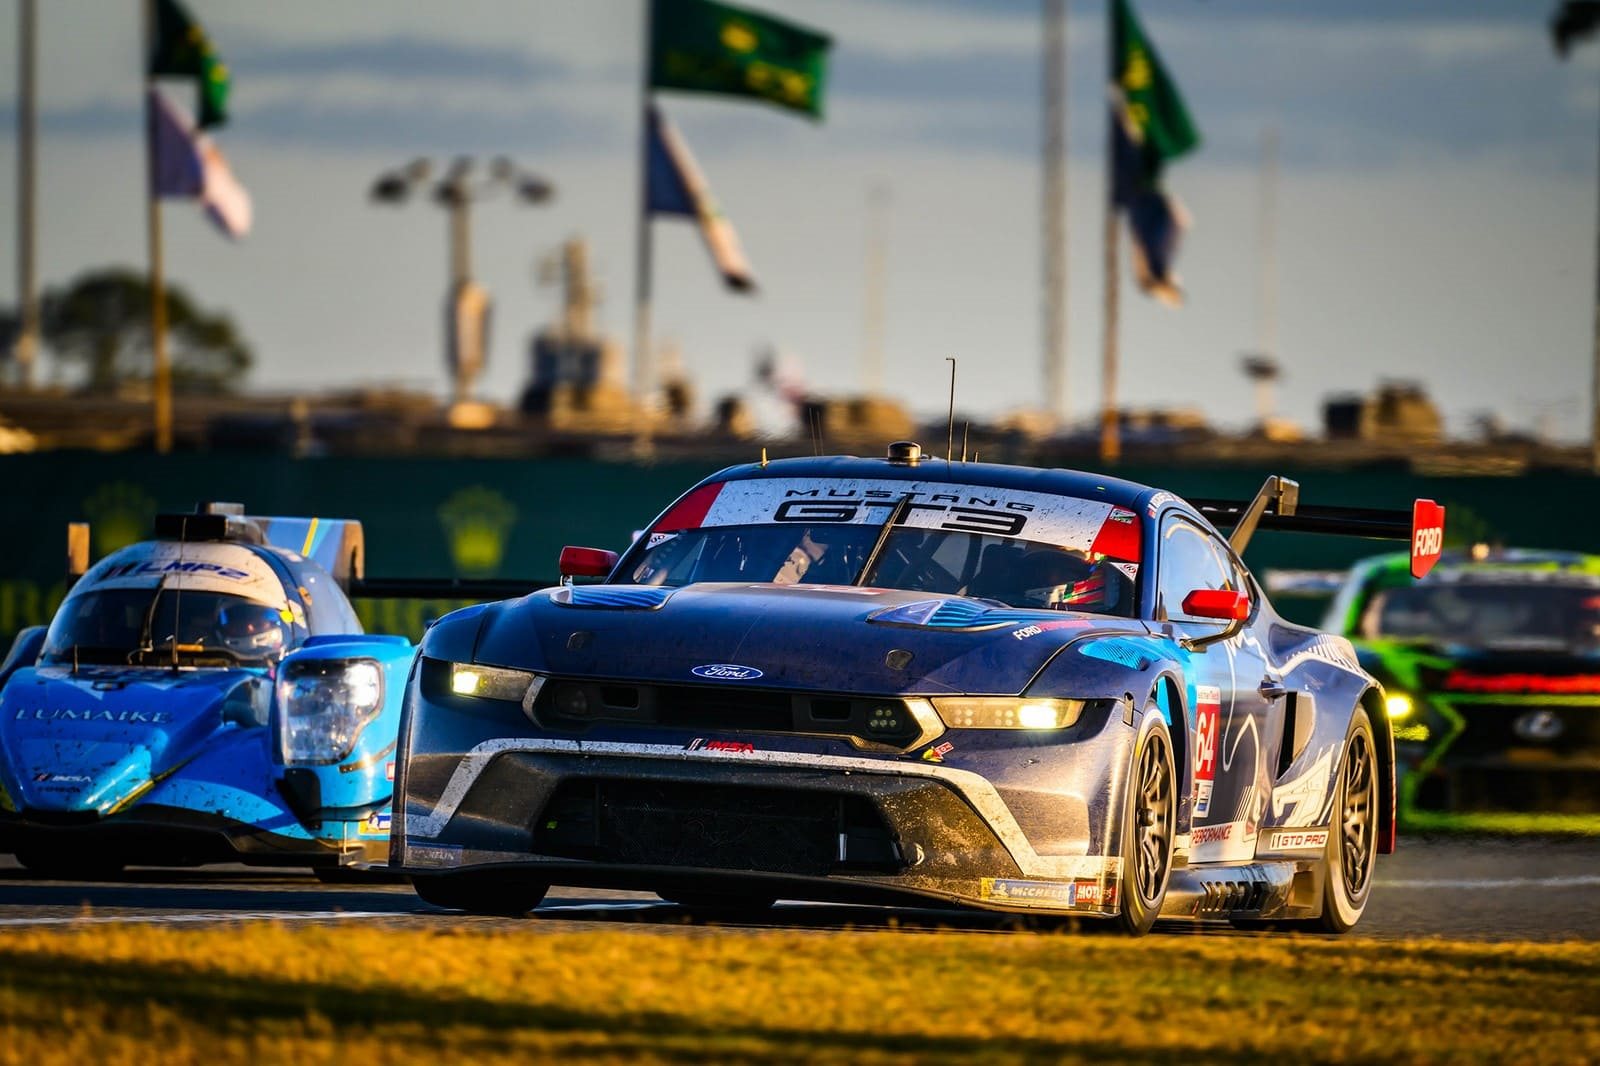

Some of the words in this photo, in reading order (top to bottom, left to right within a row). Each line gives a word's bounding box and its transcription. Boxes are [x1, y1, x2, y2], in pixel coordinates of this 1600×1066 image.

[785, 489, 1036, 512] MUSTANG
[773, 500, 1028, 536] GT3
[1413, 527, 1442, 557] FORD
[135, 560, 249, 580] LMP2
[1012, 625, 1042, 640] FORD
[704, 665, 749, 678] Ford
[16, 708, 172, 724] LUMAIKE
[705, 741, 754, 753] IMSA
[1195, 712, 1216, 772] 64
[1281, 835, 1302, 847] GTD
[1305, 834, 1326, 845] PRO
